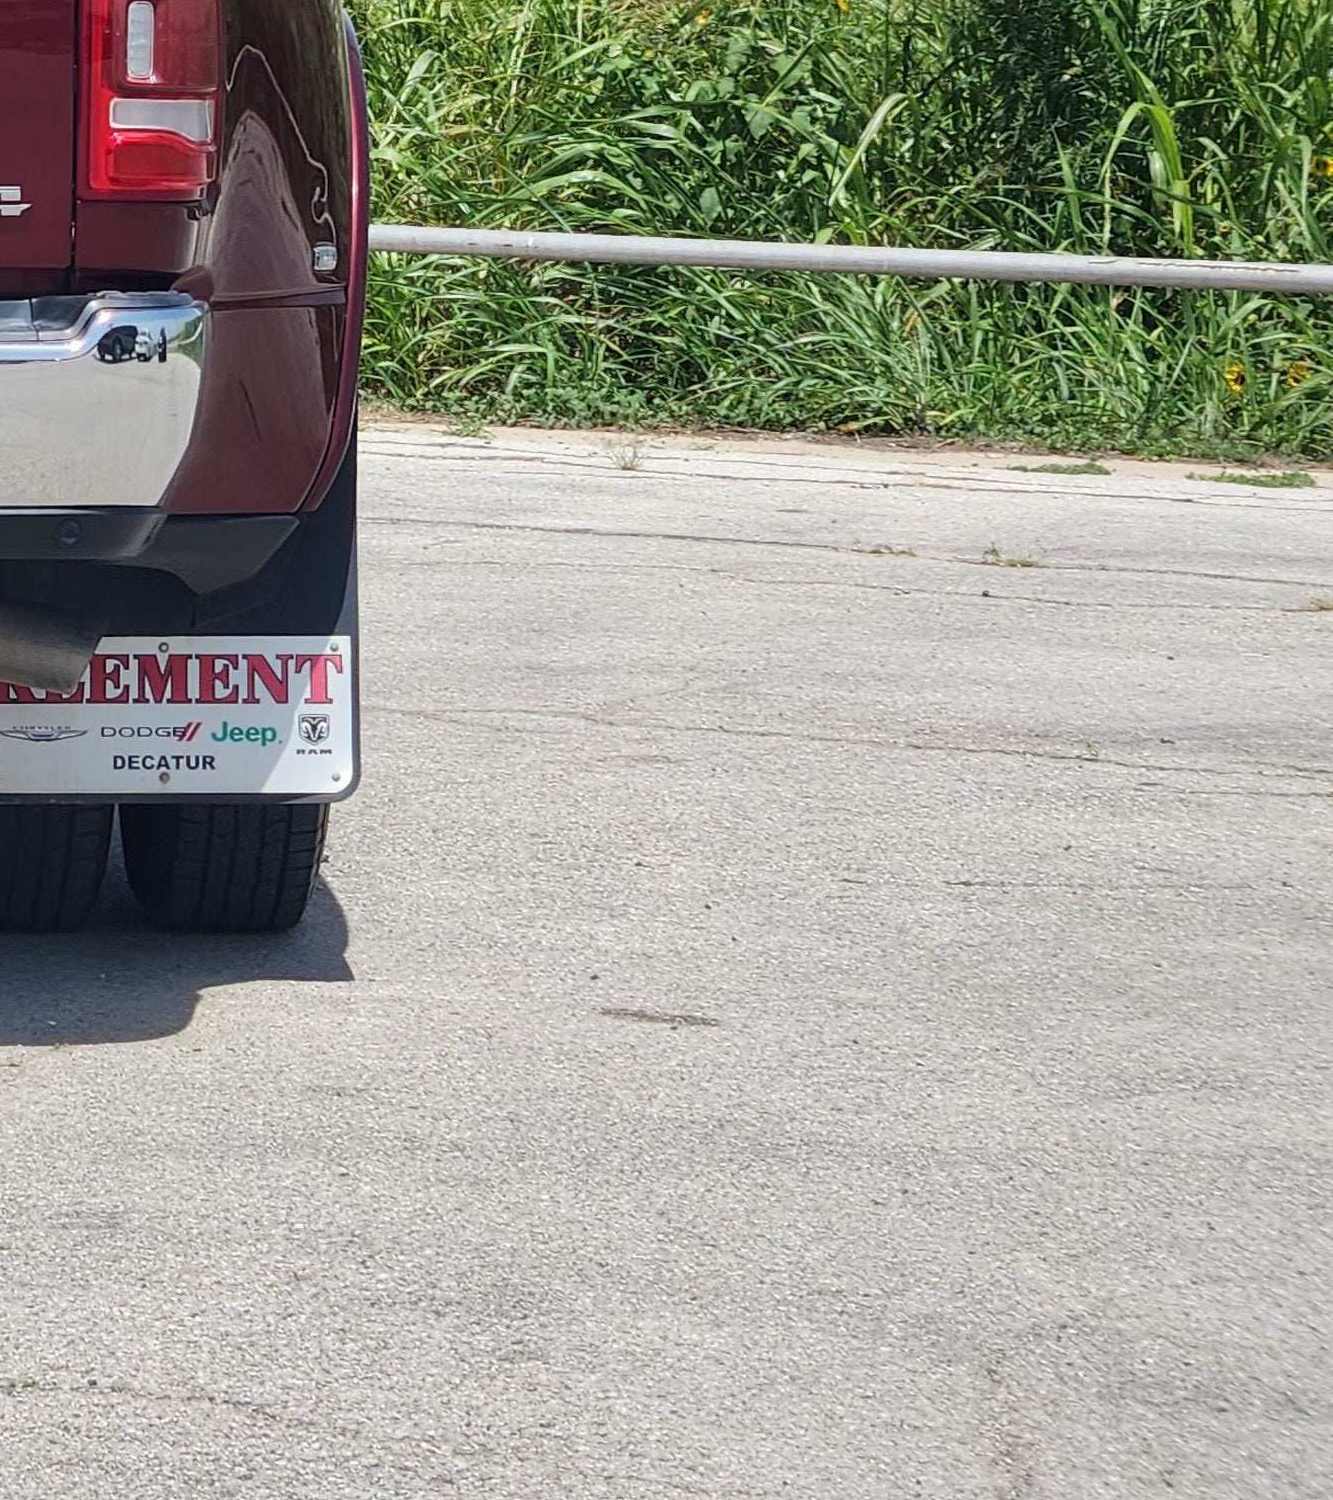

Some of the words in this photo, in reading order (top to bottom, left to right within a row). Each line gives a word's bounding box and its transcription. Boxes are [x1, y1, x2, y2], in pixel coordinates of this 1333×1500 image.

[101, 725, 186, 738] DODGE
[211, 721, 278, 746] Jeep
[113, 754, 216, 771] DECATUR
